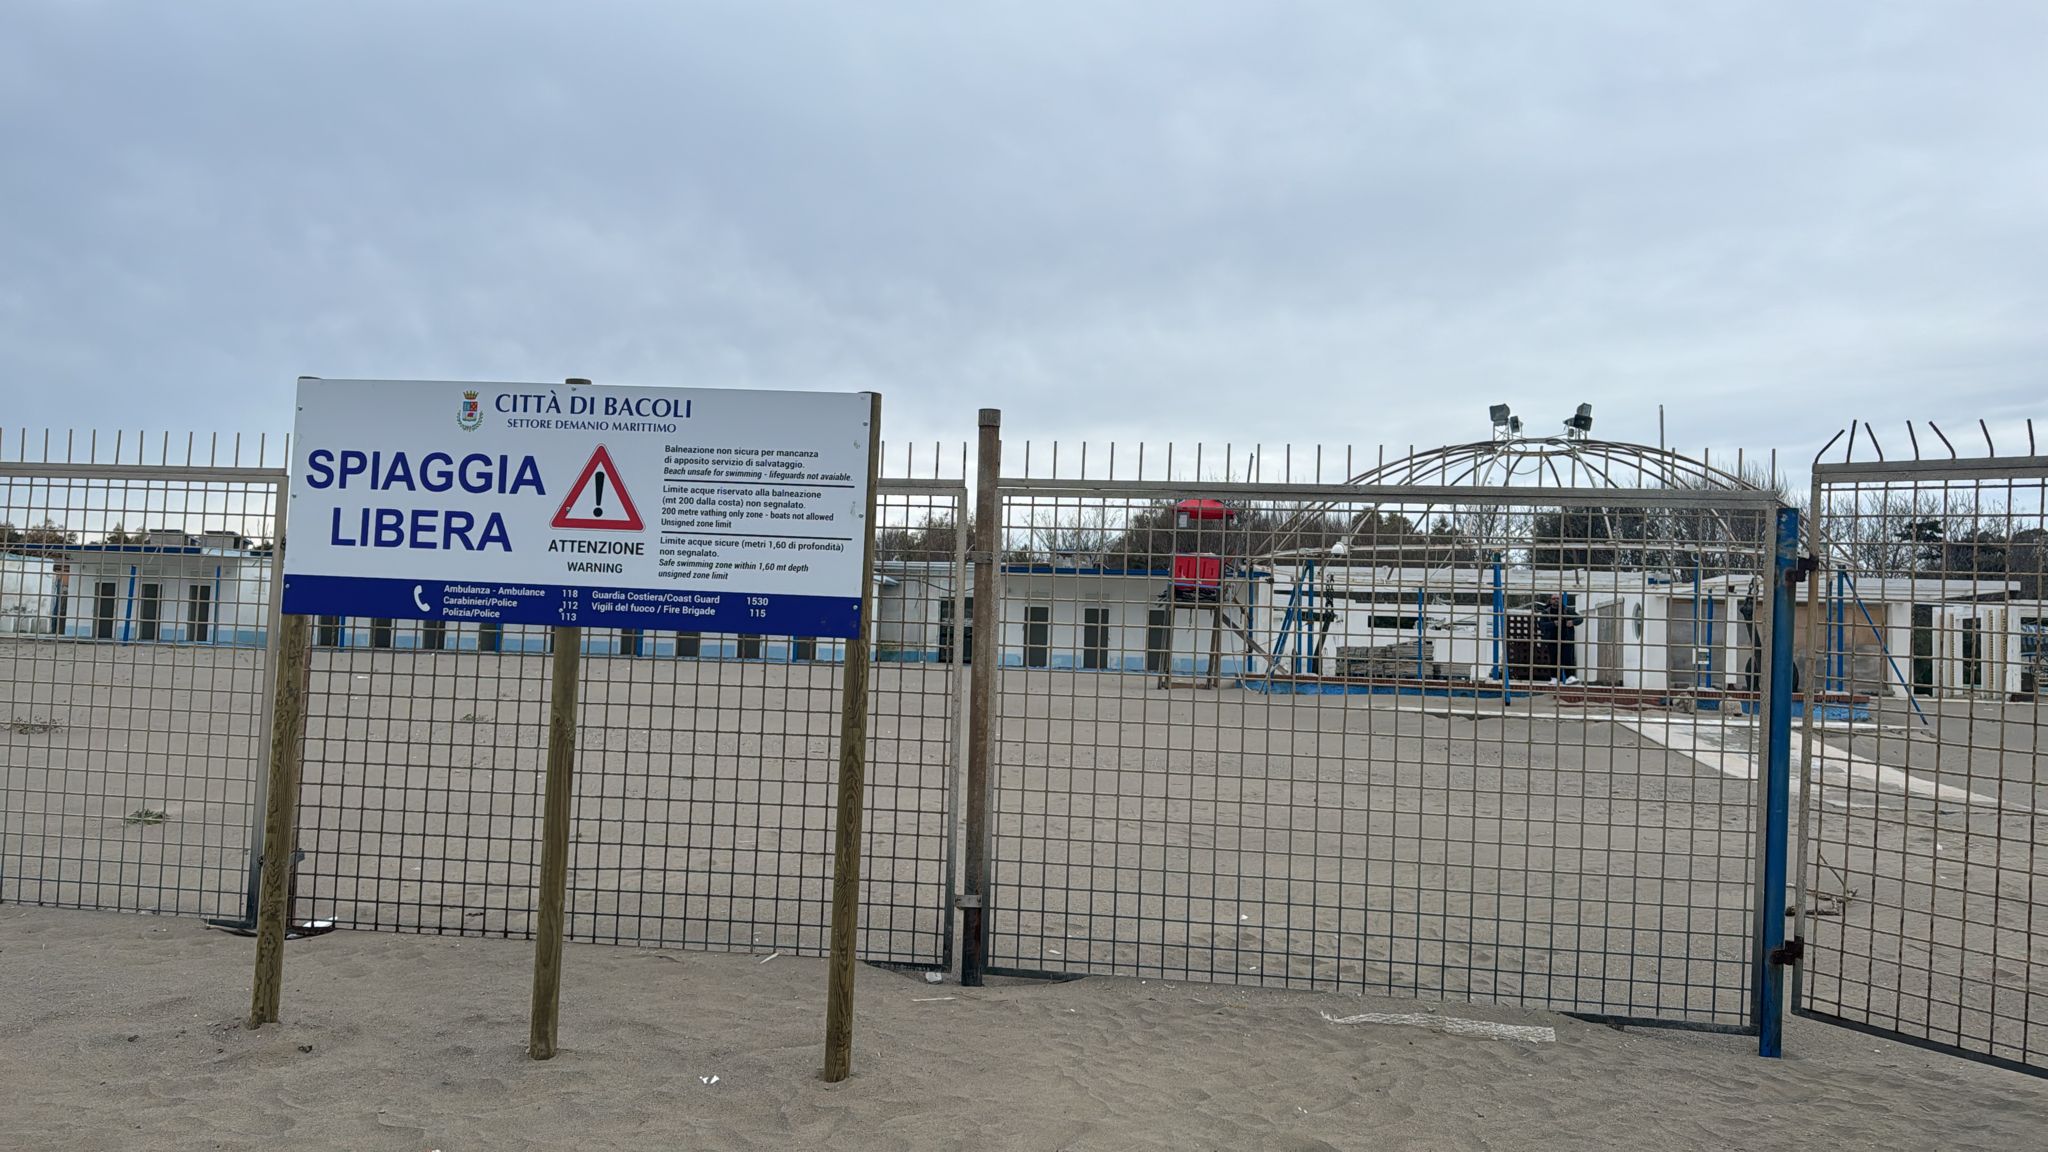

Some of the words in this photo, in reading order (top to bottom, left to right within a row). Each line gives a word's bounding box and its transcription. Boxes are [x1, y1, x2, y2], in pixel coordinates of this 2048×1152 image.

[495, 390, 561, 414] CITTÀ
[570, 396, 595, 414] DI
[604, 398, 692, 418] BACOLI
[507, 419, 552, 428] SETTORE
[555, 420, 609, 430] DEMANIO
[612, 422, 676, 433] MARITTIMO
[665, 445, 714, 454] Balneazione
[734, 447, 759, 456] sicura
[761, 449, 774, 458] per
[674, 457, 709, 466] apposito
[756, 460, 805, 469] salvataggio.
[306, 449, 546, 495] SPIAGGIA
[726, 470, 762, 479] swimming
[769, 472, 804, 481] lifeguards
[663, 485, 688, 494] Limite
[690, 488, 714, 496] acque
[717, 487, 753, 496] riservato
[755, 488, 770, 497] alla
[772, 489, 821, 498] balneazione
[662, 497, 676, 505] (mt
[696, 497, 716, 506] dalla
[718, 499, 743, 507] costa)
[764, 500, 806, 509] segnalato.
[700, 509, 726, 518] vathing
[728, 511, 744, 519] only
[806, 513, 834, 521] allowed
[330, 507, 513, 552] LIBERA
[661, 519, 694, 528] Unsigned
[548, 539, 644, 555] ATTENZIONE
[660, 537, 685, 545] Limite
[688, 539, 712, 547] acque
[715, 539, 739, 547] sicure
[741, 540, 766, 549] (metri
[769, 541, 786, 550] 1,60
[798, 542, 844, 552] profondità)
[677, 549, 719, 558] segnalato.
[567, 562, 623, 574] WARNING
[677, 560, 713, 569] swimming
[734, 561, 756, 570] within
[759, 563, 774, 571] 1,60
[788, 564, 808, 572] depth
[658, 571, 690, 579] unsigned
[711, 571, 728, 579] limit
[444, 584, 490, 594] Ambulanza
[499, 587, 545, 596] Ambulance
[443, 596, 517, 607] Carabinieri/Police
[562, 601, 578, 609] 112
[592, 591, 625, 599] Guardia
[628, 592, 692, 602] Costiera/Coast
[694, 595, 720, 604] Guard
[747, 597, 768, 605] 1530
[443, 608, 500, 618] Polizia/Police
[592, 602, 613, 612] Vigili
[664, 605, 680, 614] Fire
[682, 607, 715, 616] Brigade
